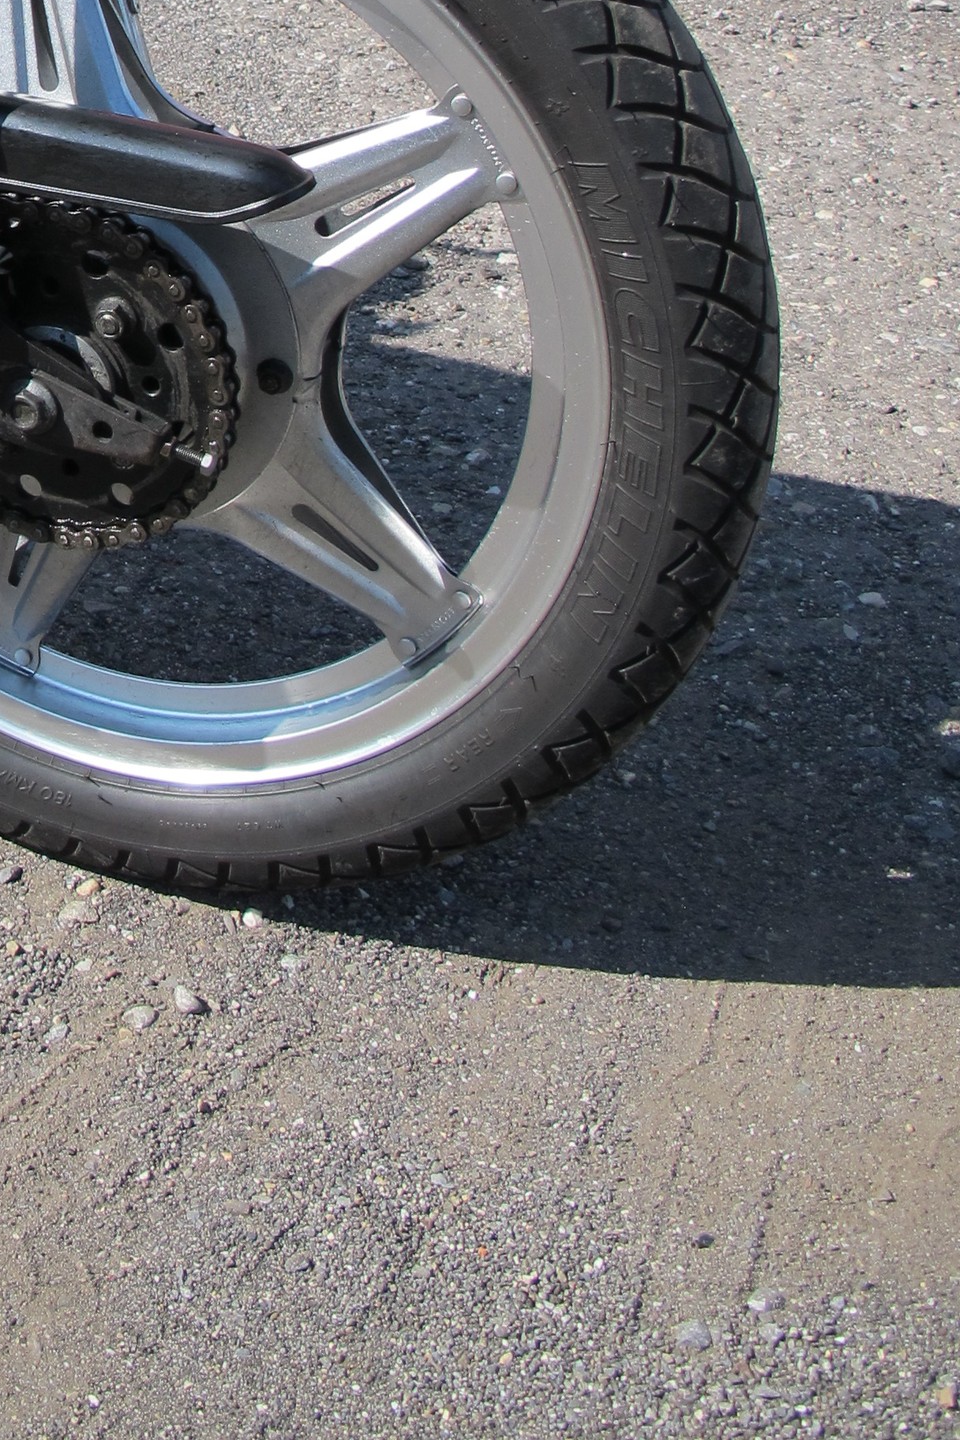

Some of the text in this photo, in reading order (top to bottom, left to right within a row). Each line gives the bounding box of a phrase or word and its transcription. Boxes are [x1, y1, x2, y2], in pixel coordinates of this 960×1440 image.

[568, 160, 665, 644] MICHELIN
[443, 727, 495, 772] REAR
[41, 785, 73, 807] 180
